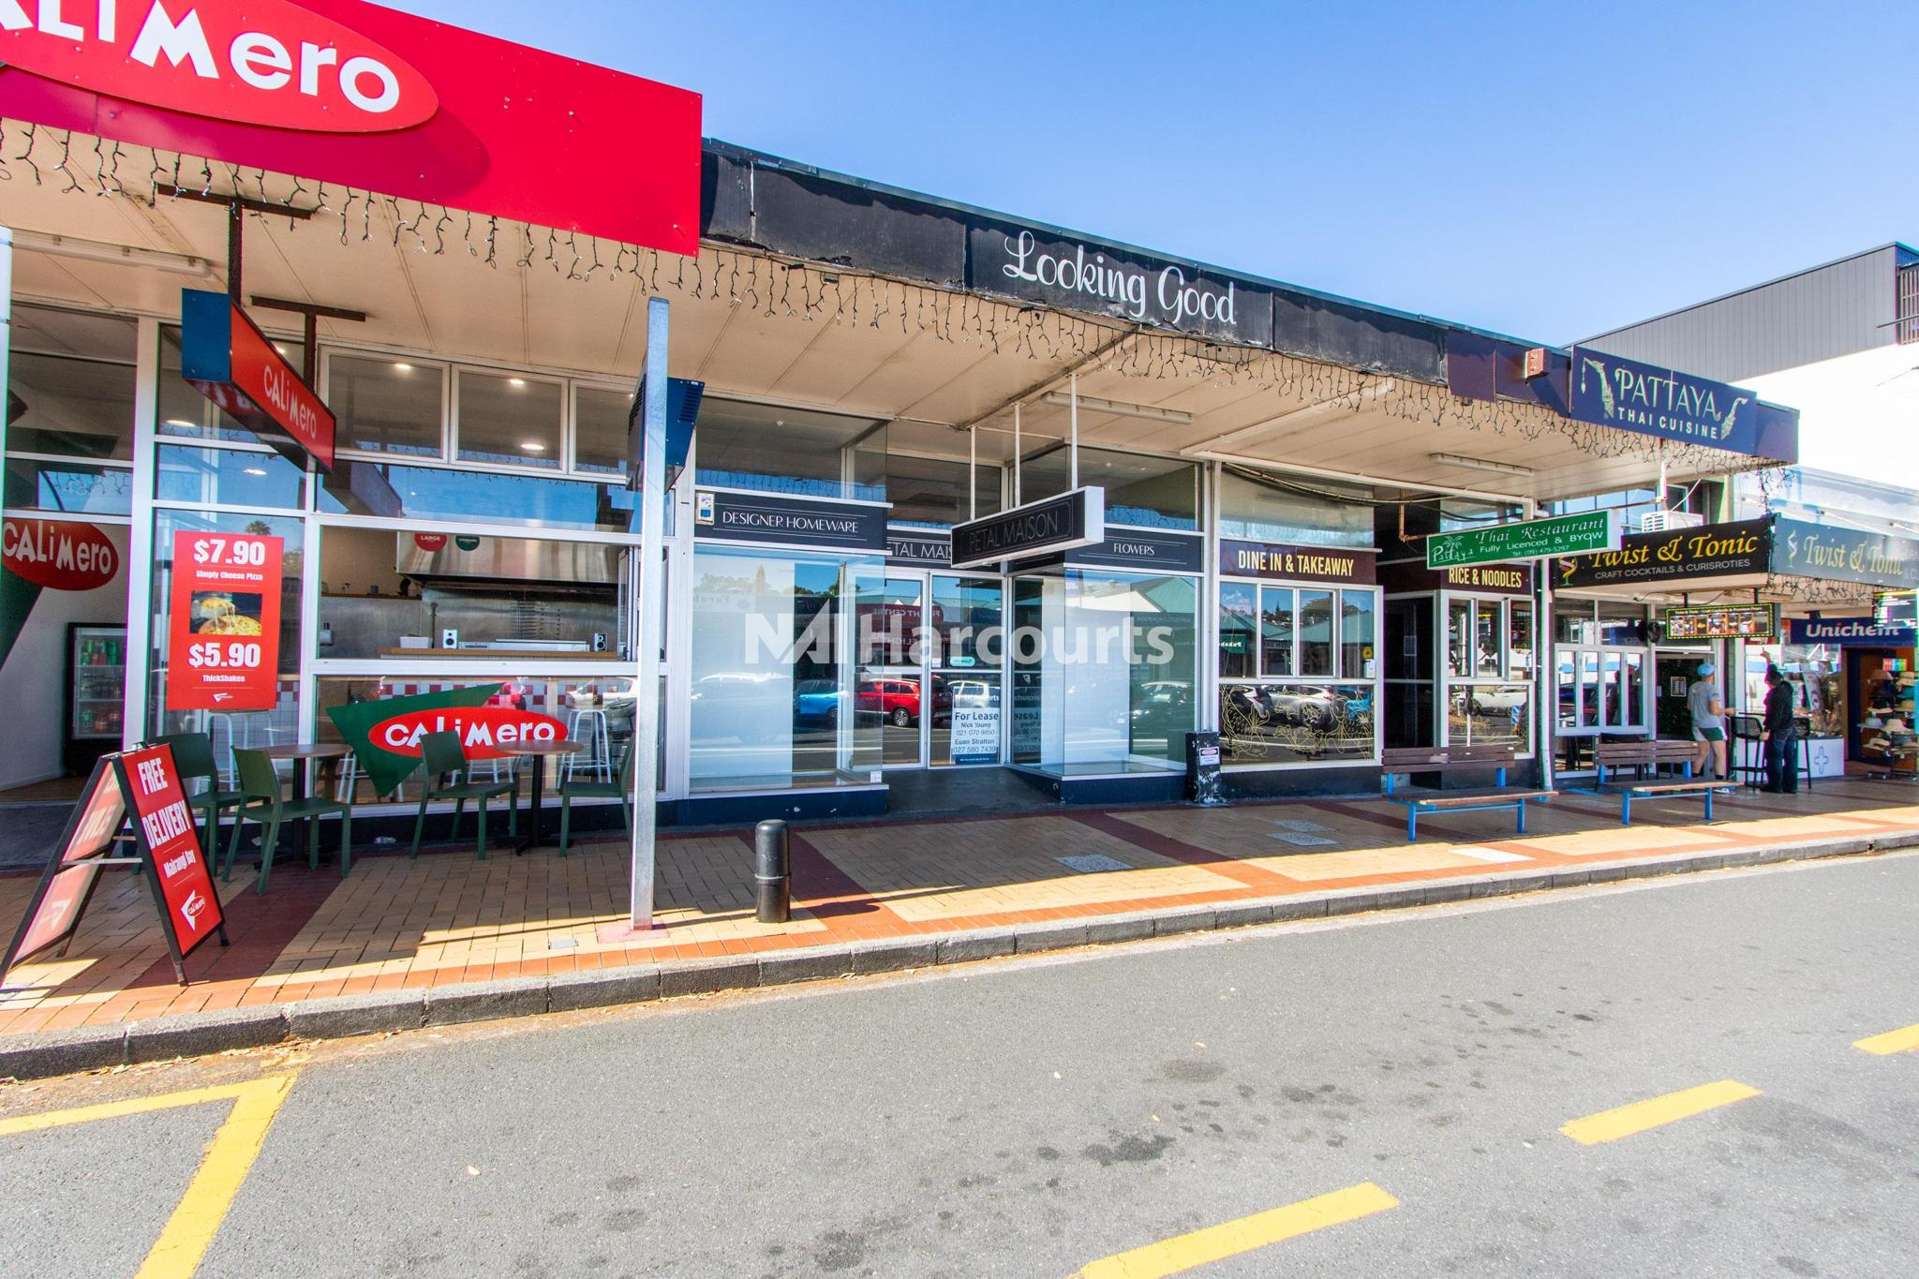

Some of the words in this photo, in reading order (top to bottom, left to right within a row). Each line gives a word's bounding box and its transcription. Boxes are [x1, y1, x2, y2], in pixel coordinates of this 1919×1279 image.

[1002, 231, 1145, 317] Looking
[1158, 266, 1236, 324] Good
[1615, 367, 1722, 422] PATTAYA
[1618, 407, 1652, 426] THAI
[1659, 416, 1718, 440] CUISINE
[722, 511, 784, 528] DESIGNER
[786, 517, 859, 533] HOMEWARE
[969, 527, 1000, 552] PETAL
[1003, 510, 1058, 544] MAISON
[1475, 530, 1510, 545] Thai
[1521, 517, 1604, 540] Restaurant
[3, 519, 111, 575] CALiMero
[194, 539, 265, 566] $7.90
[1113, 543, 1155, 556] FLOWERS
[1480, 544, 1500, 554] Fully
[1506, 538, 1549, 550] Licenced
[1553, 536, 1563, 544] &
[1570, 531, 1603, 542] BYOW
[1591, 542, 1649, 569] Twist
[1657, 536, 1683, 562] &
[1688, 530, 1760, 558] Tonic
[1803, 534, 1846, 568] Twist
[1849, 540, 1867, 573] &
[1238, 550, 1267, 570] DINE
[1270, 553, 1282, 571] IN
[1285, 554, 1294, 573] &
[1297, 555, 1354, 576] TAKEAWAY
[1595, 571, 1622, 580] CRAFT
[1625, 566, 1675, 578] COCKTAILS
[1448, 567, 1469, 584] RICE
[1472, 568, 1479, 584] &
[1482, 569, 1522, 588] NOODLES
[189, 642, 261, 668] $5.90
[955, 712, 970, 721] For
[973, 711, 999, 721] Lease
[138, 757, 168, 795] FREE
[142, 800, 191, 849] DELIVERY
